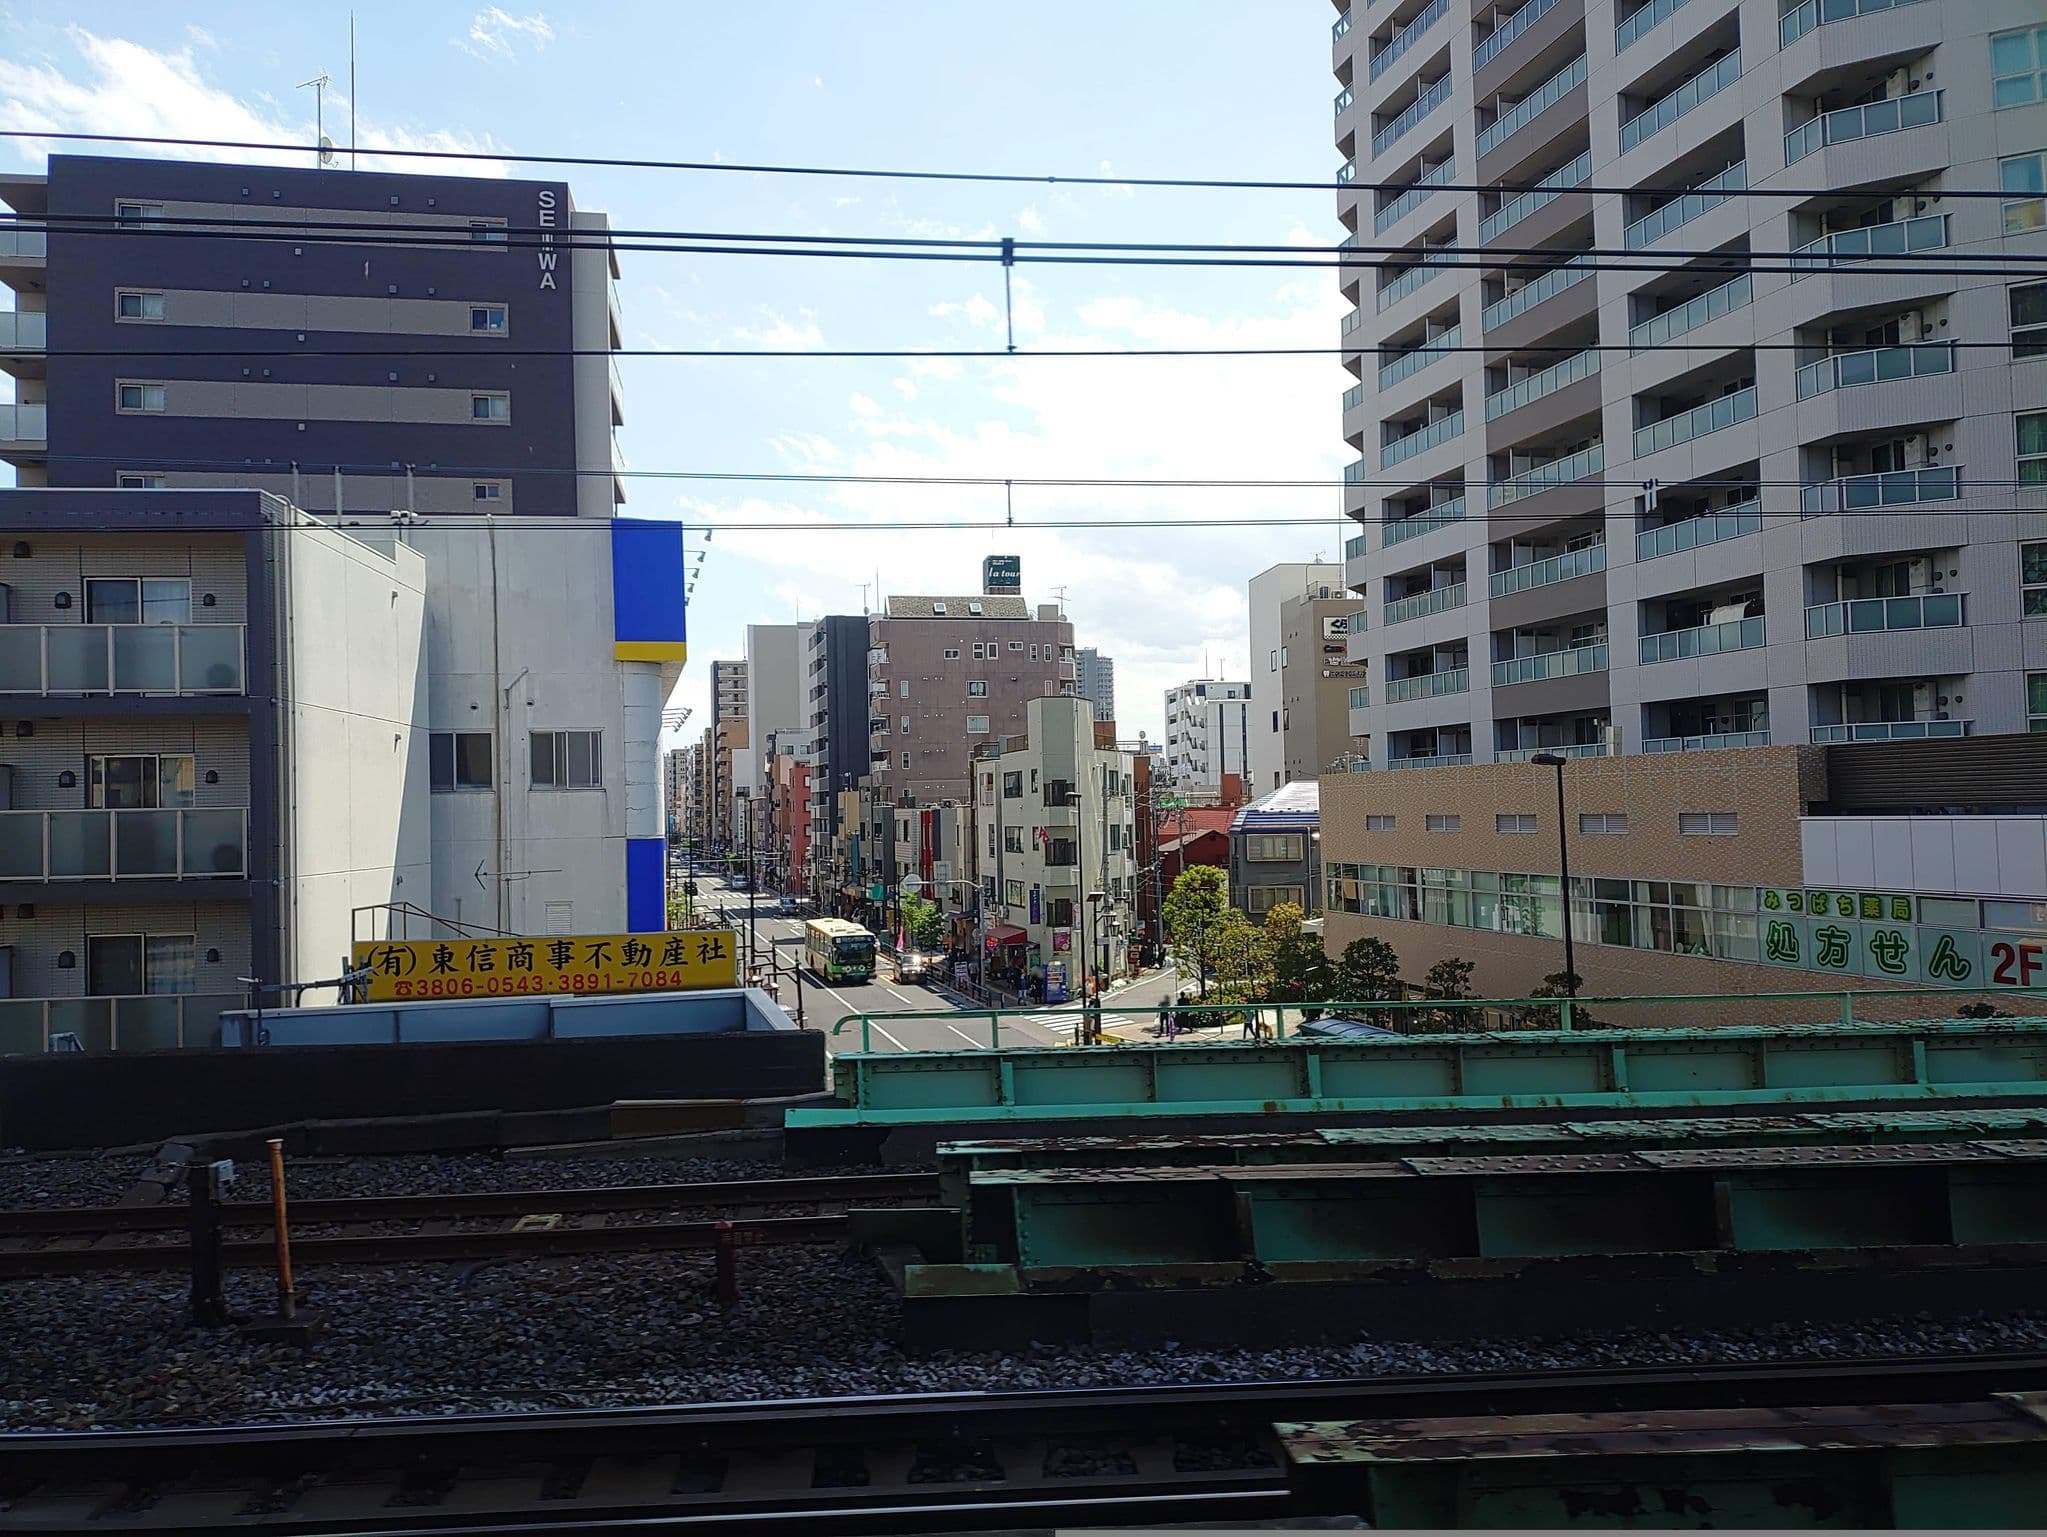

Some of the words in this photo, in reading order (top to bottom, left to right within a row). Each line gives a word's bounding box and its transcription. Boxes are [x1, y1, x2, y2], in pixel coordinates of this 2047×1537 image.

[1764, 890, 1911, 920] みつばち薬局
[367, 936, 728, 976] (有)東信商事不動産社
[1766, 920, 1972, 981] 処方せん
[1990, 942, 2044, 987] 2F
